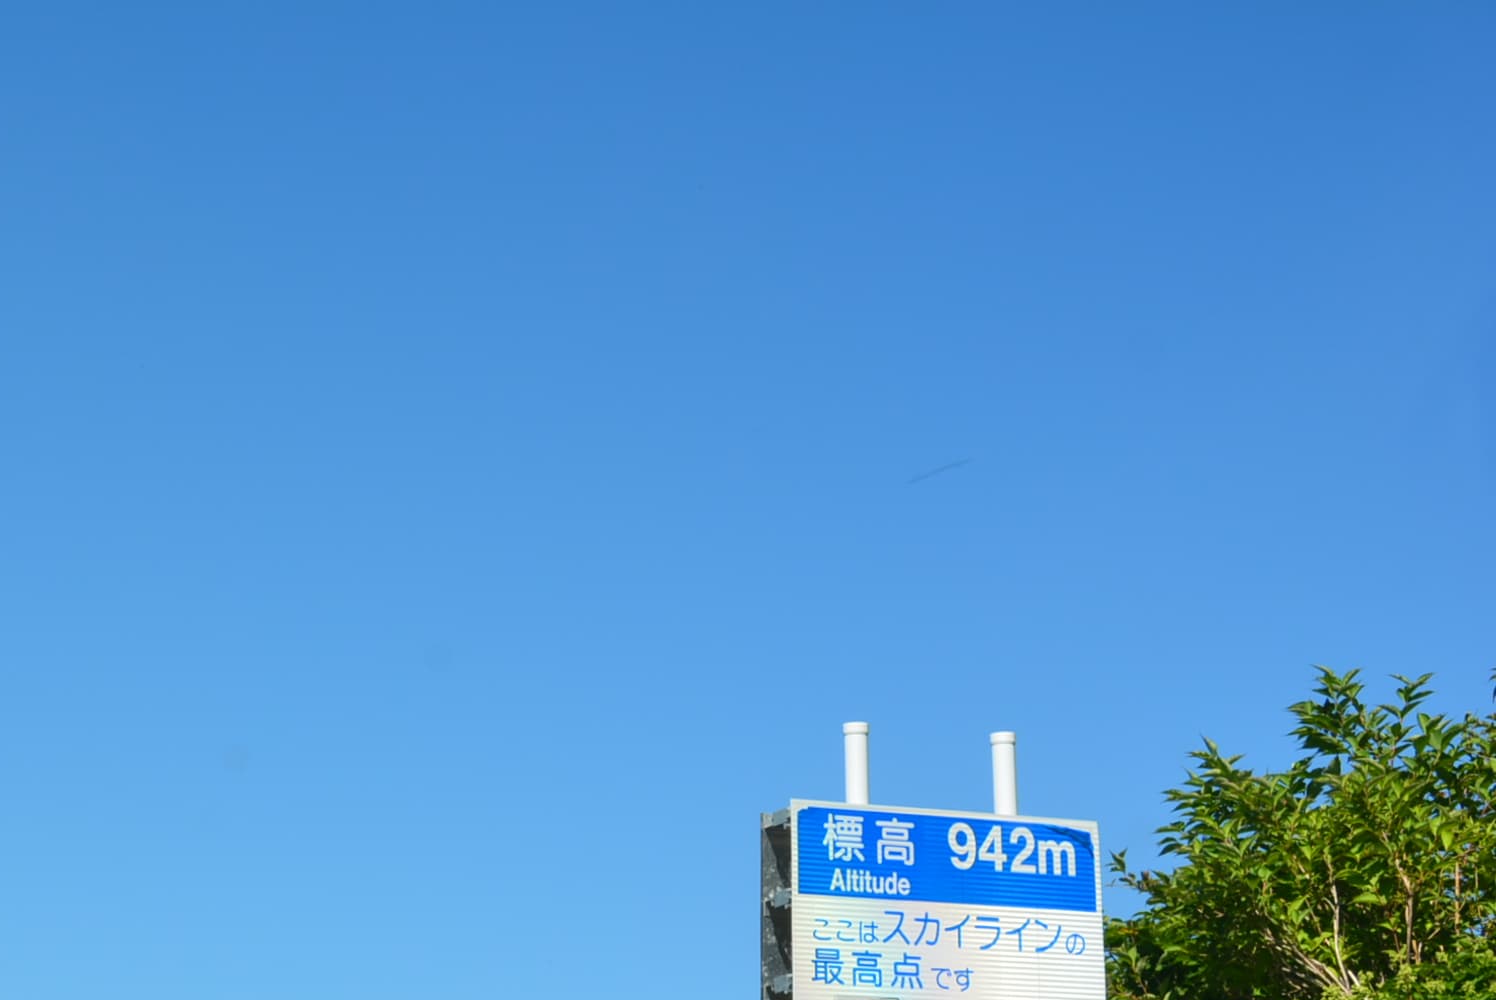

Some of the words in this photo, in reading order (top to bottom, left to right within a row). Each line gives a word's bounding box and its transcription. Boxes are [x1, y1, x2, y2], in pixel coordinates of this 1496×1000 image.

[822, 813, 915, 866] 標高
[947, 822, 1077, 877] 942m
[829, 868, 912, 896] Altitude
[812, 911, 1086, 955] ここはスカイラインの
[811, 948, 975, 991] 最高点です
